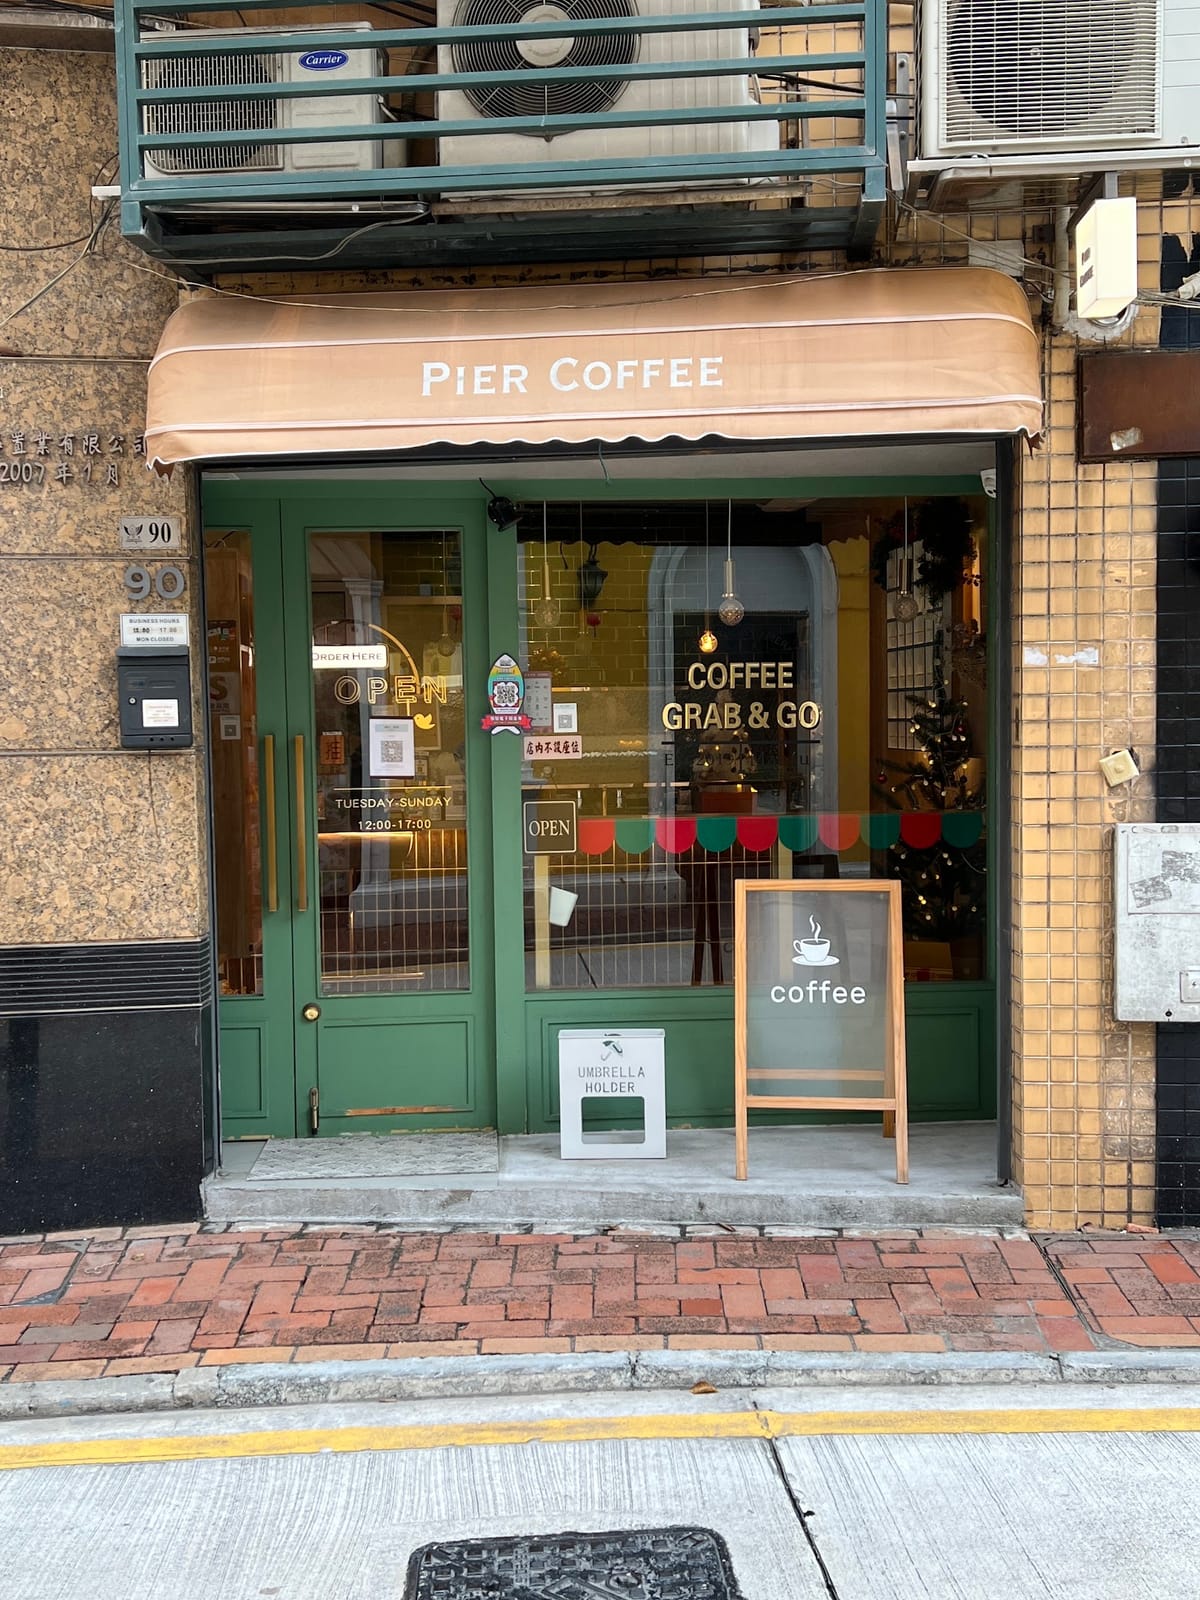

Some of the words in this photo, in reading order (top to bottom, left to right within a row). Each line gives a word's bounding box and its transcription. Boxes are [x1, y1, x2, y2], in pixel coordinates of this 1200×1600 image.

[305, 54, 342, 65] Carrier
[421, 361, 529, 396] PIER
[549, 356, 724, 392] COFFEE
[0, 432, 147, 456] 置業有限公司
[148, 522, 172, 543] 90
[124, 566, 185, 600] 90
[312, 652, 349, 661] ORDER
[352, 651, 383, 661] HERE
[688, 661, 794, 690] COFFEE
[335, 675, 447, 704] OPEN
[662, 702, 742, 730] GRAB
[748, 701, 770, 729] &
[776, 701, 820, 729] GO
[335, 796, 452, 809] TUESDAY-SUNDAY
[358, 819, 432, 830] 12:00-17:00
[529, 819, 570, 837] OPEN
[770, 980, 866, 1004] coffee
[578, 1065, 646, 1078] UMBRELLA
[585, 1081, 635, 1093] HOLDER
